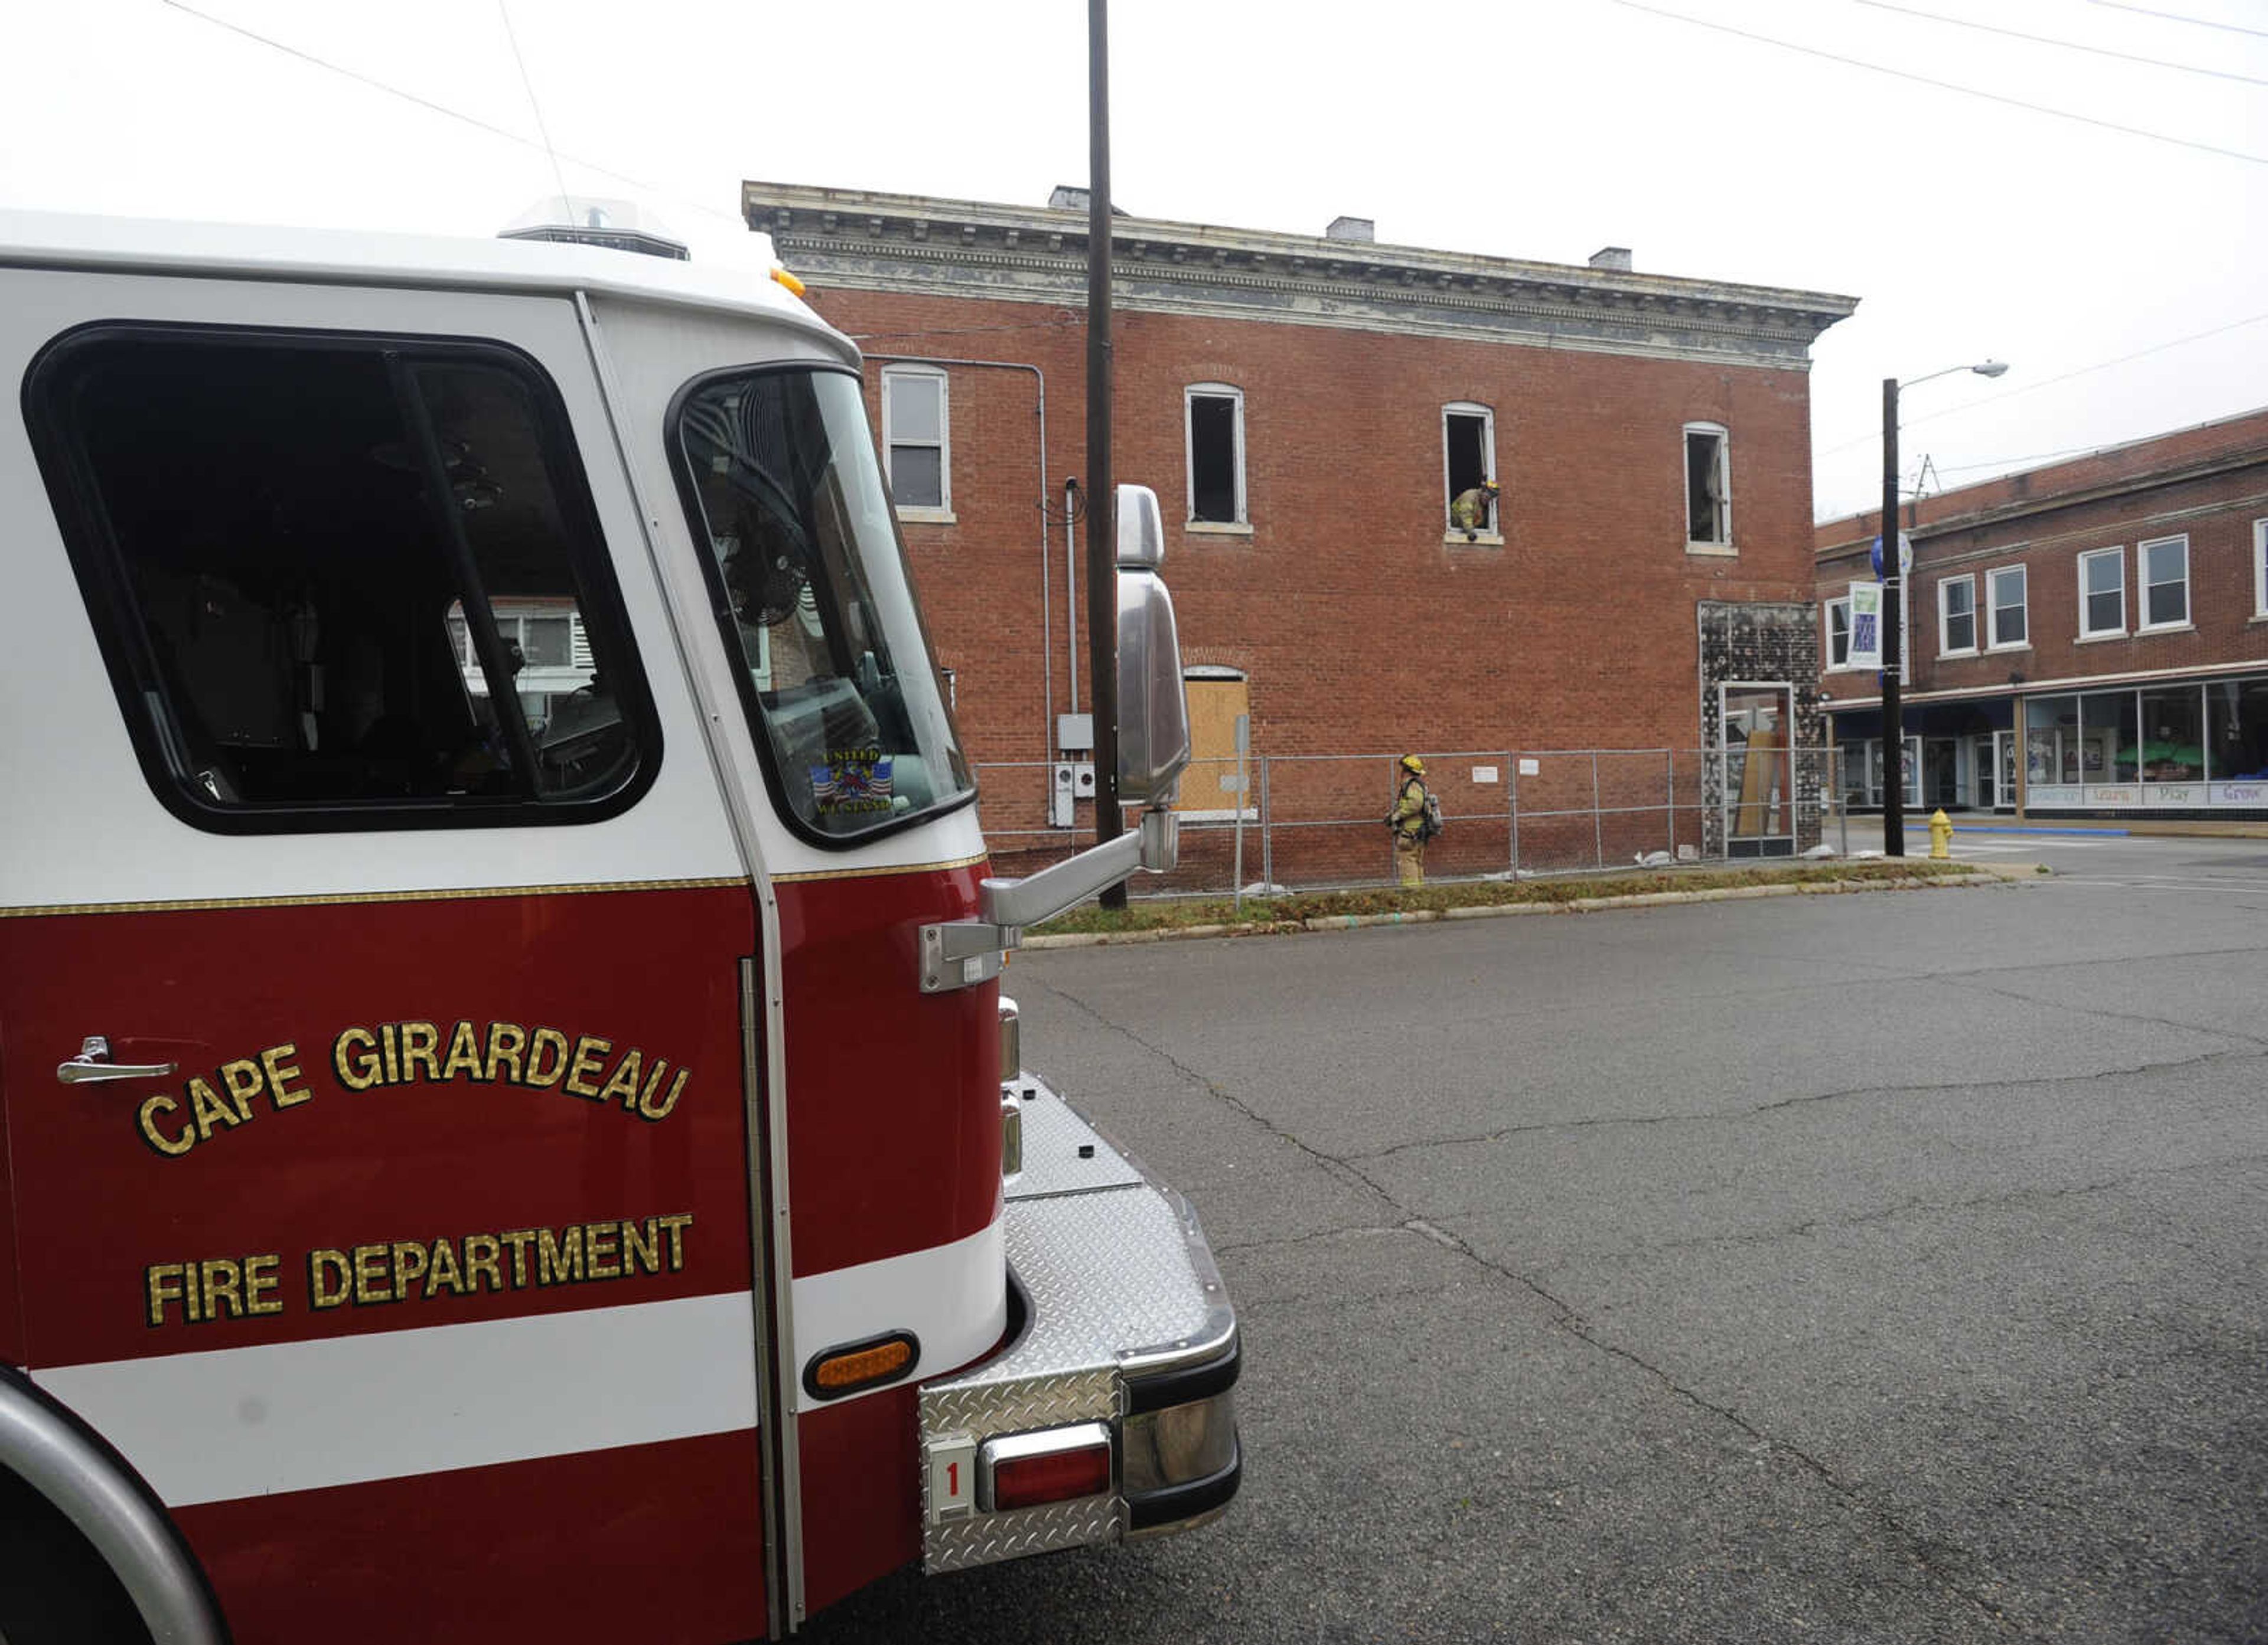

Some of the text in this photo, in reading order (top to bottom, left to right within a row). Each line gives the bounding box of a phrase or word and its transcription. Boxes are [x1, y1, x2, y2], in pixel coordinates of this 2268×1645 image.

[2158, 786, 2189, 802] Play
[2223, 783, 2261, 800] Grow
[136, 1020, 690, 1157] CAPE GIRARDEAU
[146, 1213, 694, 1327] FIRE DEPARTMENT
[947, 1462, 958, 1496] 1
